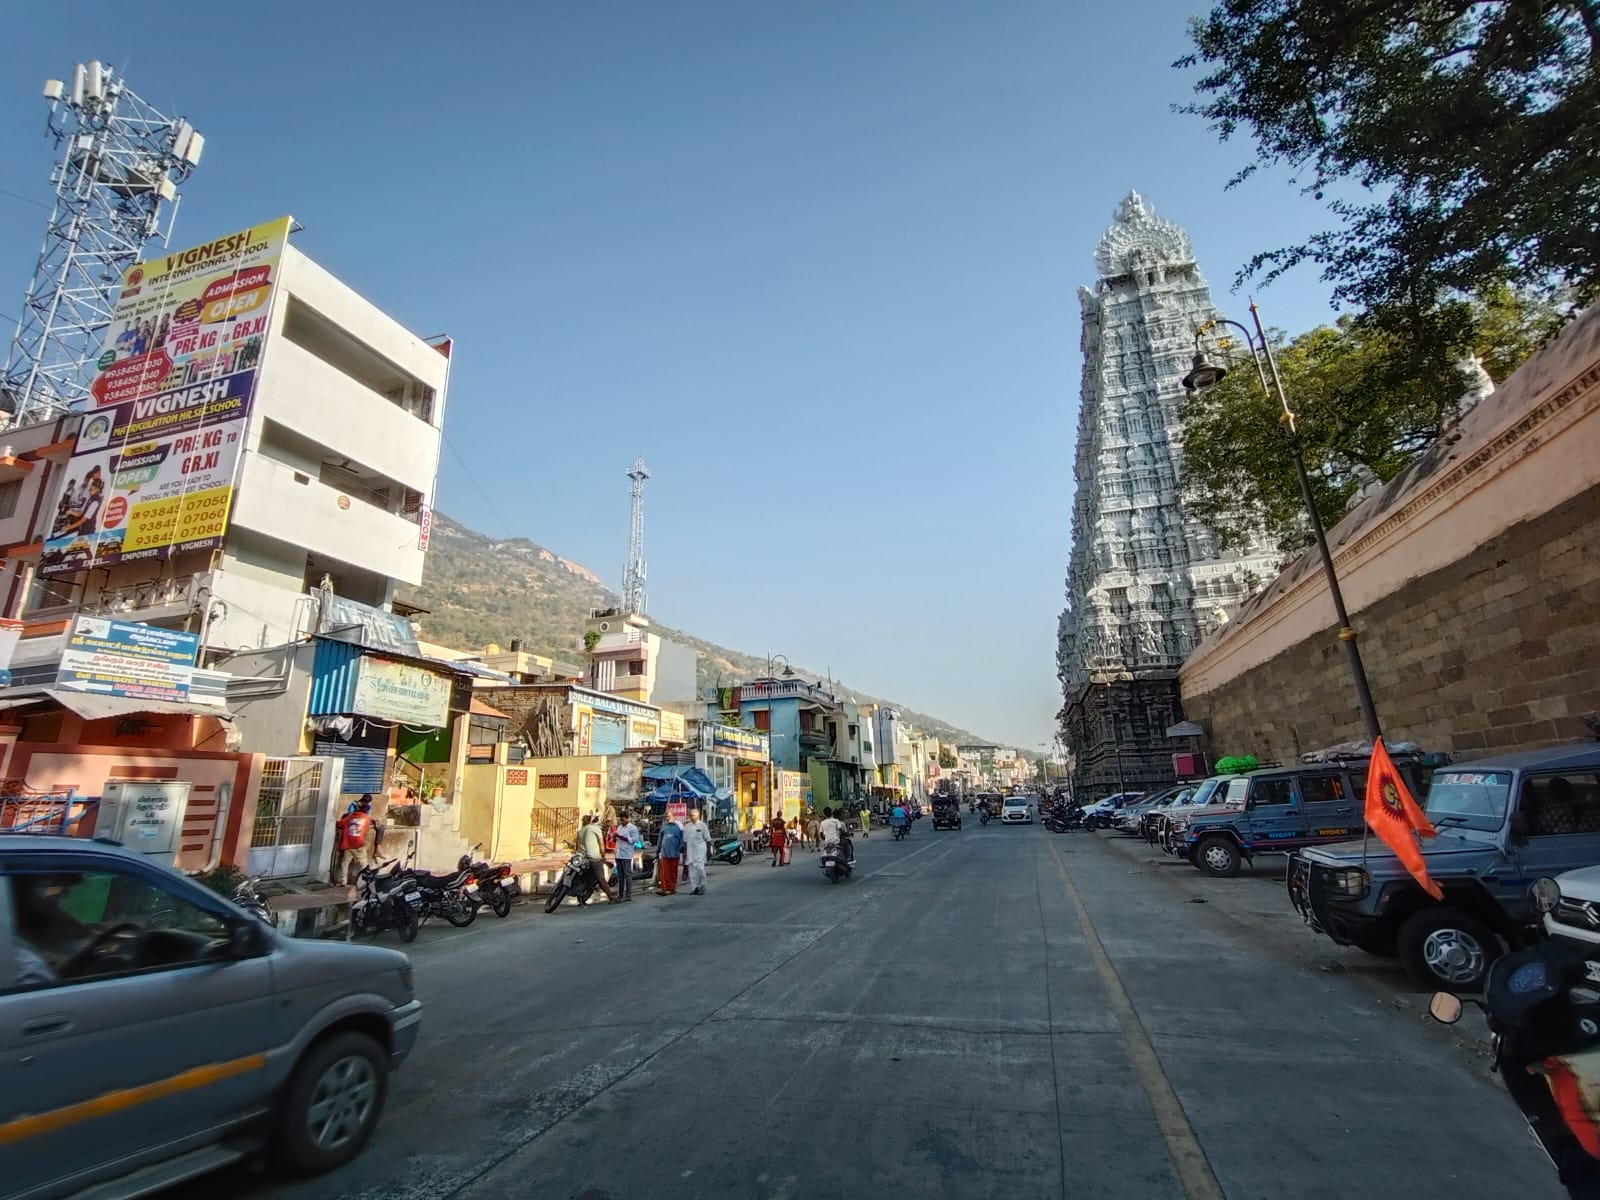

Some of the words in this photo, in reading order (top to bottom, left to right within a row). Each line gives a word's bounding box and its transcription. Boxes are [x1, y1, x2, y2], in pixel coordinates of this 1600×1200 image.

[166, 230, 252, 271] VIGNESH
[148, 255, 227, 286] INTERNATIONAL
[229, 241, 269, 263] SCHOOL
[206, 272, 265, 297] ADMISSION
[211, 291, 258, 318] OPEN
[173, 336, 198, 356] PRE
[199, 330, 218, 350] KG
[232, 315, 267, 340] GR.XI
[135, 379, 230, 419] VIGNESH
[112, 413, 179, 437] MATRICULATION
[202, 429, 223, 448] KG
[227, 432, 237, 443] TO
[114, 453, 162, 470] ADMISSION
[181, 451, 220, 474] GR.XI
[117, 469, 150, 486] OPEN
[159, 481, 171, 491] ARE
[172, 478, 183, 488] YOU
[140, 491, 160, 503] ENROLL
[161, 489, 169, 498] IN
[170, 487, 180, 496] THE
[184, 486, 197, 494] EST
[142, 503, 182, 519] 93845
[186, 494, 228, 511] 07050
[139, 517, 180, 532] 93845
[183, 508, 225, 525] 07060
[421, 511, 431, 550] ROOMS
[135, 531, 177, 546] 93845
[180, 522, 222, 538] 07080
[181, 539, 213, 551] VIGNESH
[122, 549, 158, 561] EMPOWER
